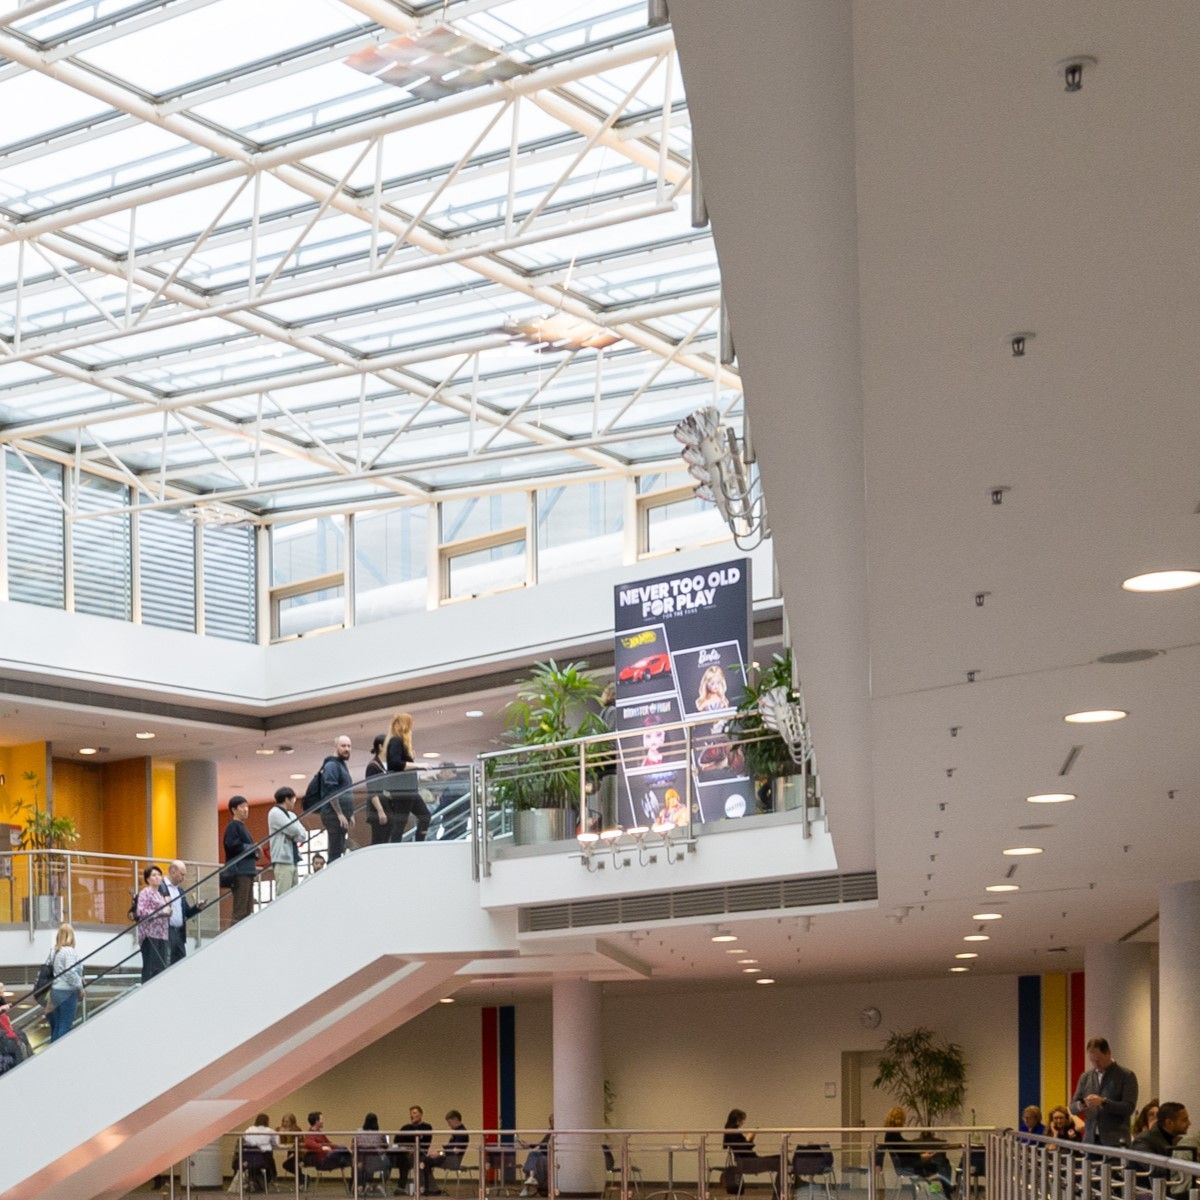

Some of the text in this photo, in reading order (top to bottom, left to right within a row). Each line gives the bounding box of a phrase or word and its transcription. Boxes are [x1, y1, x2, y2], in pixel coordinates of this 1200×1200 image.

[619, 567, 741, 607] NEVER TOO OLD
[642, 588, 716, 618] FOR PLAY
